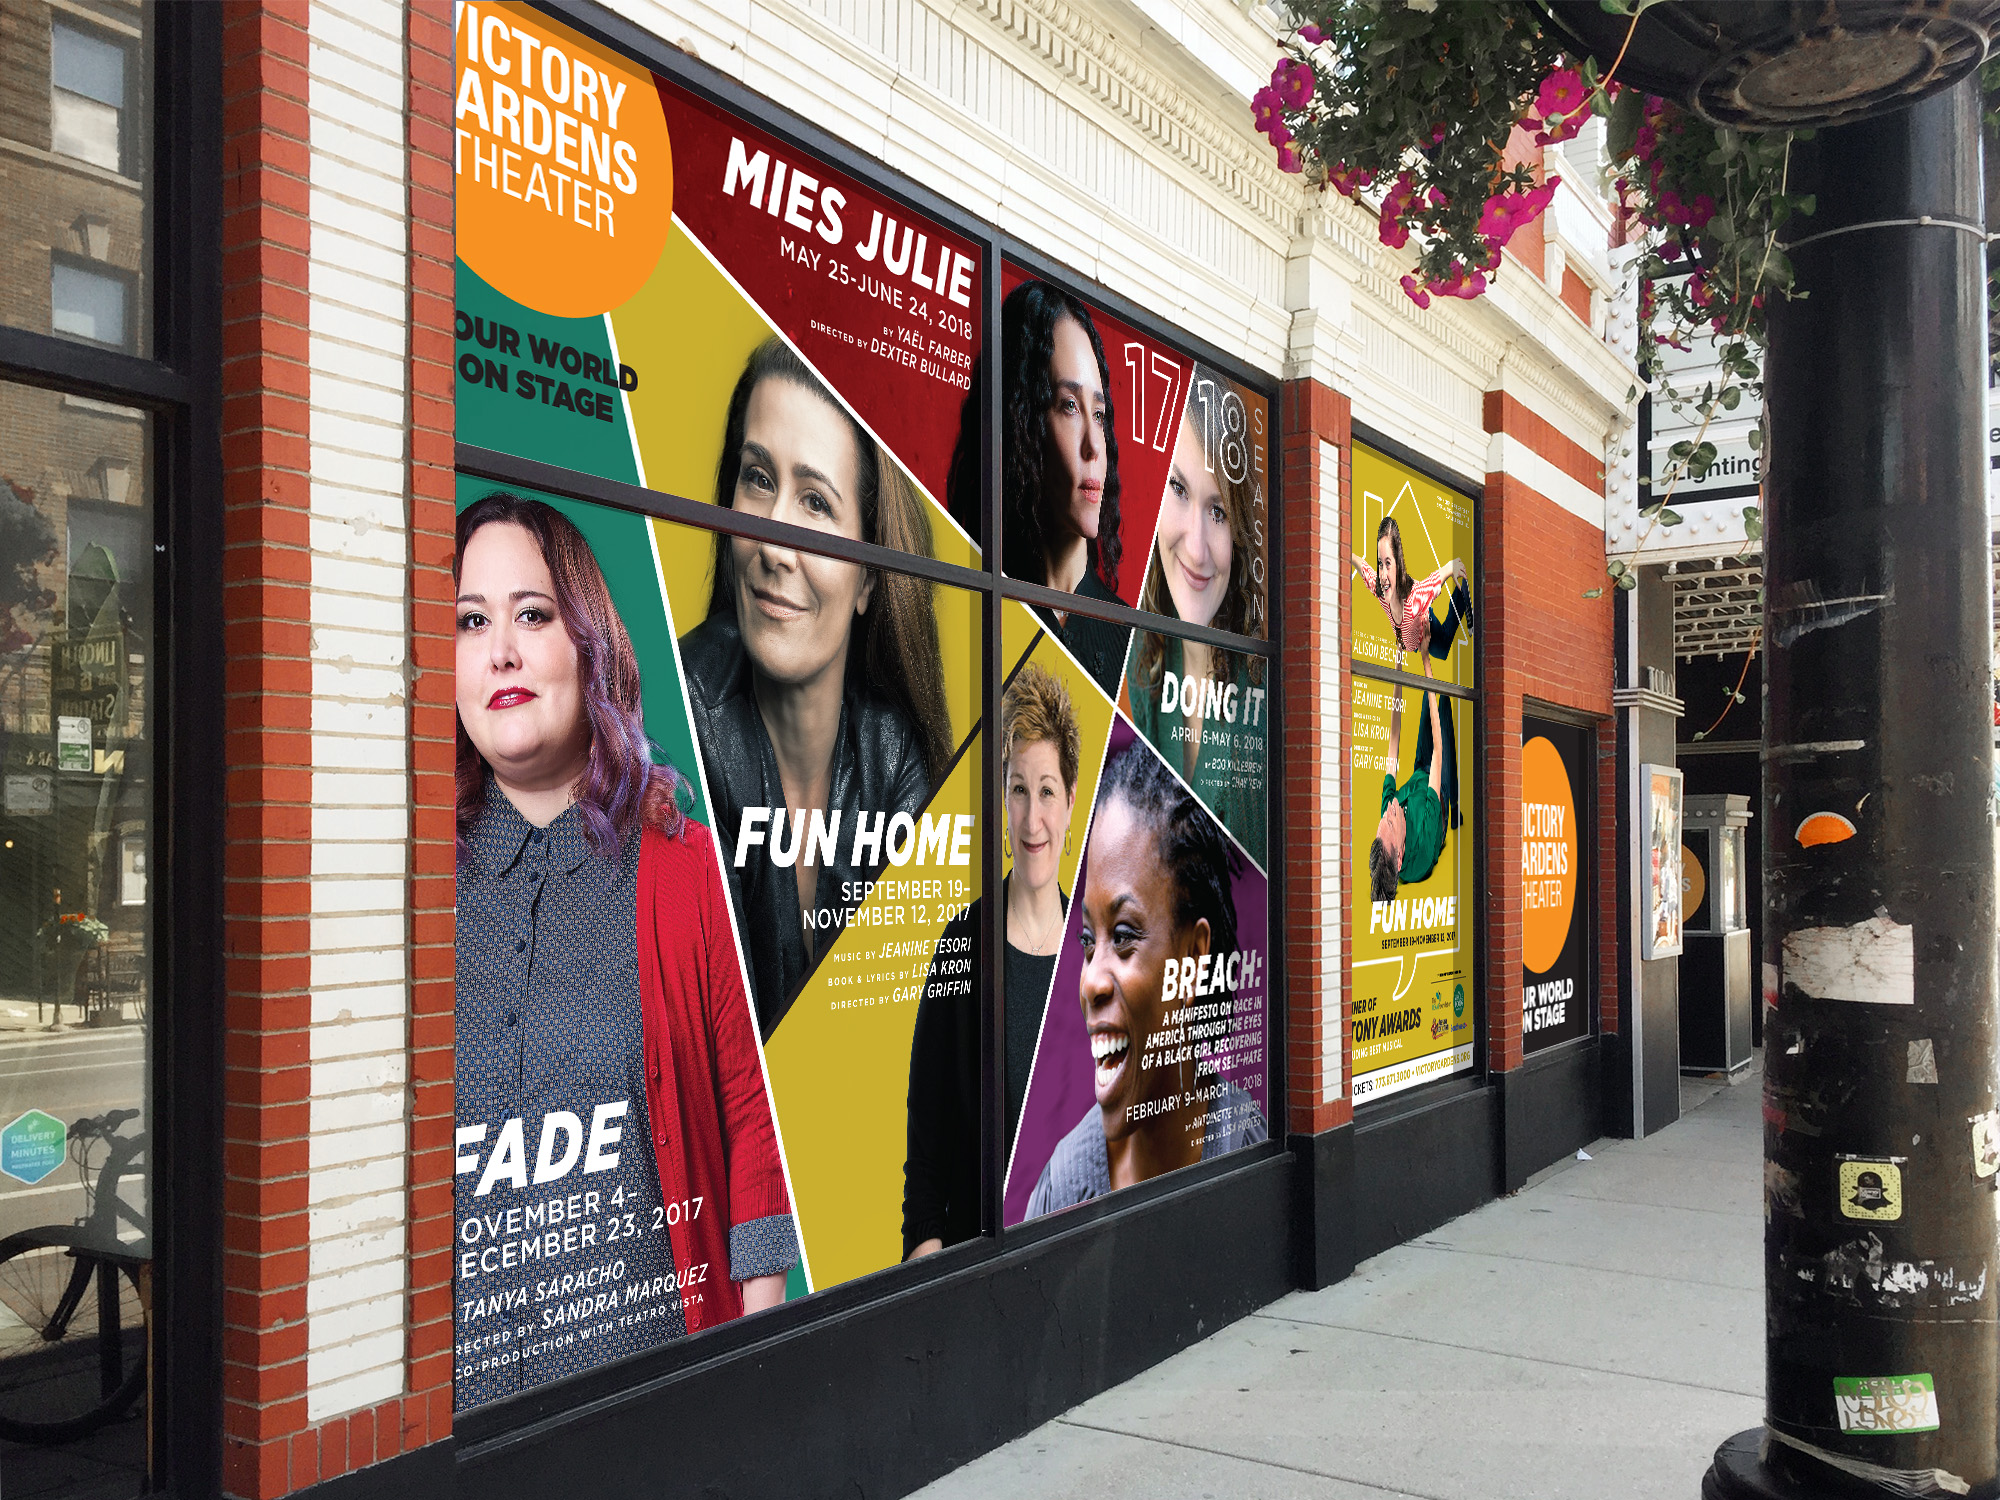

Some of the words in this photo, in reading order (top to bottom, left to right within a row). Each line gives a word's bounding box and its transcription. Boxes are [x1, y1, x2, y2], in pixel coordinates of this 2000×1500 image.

[456, 1, 627, 130] ICTORY
[722, 136, 847, 245] MIES
[855, 209, 975, 308] JULIE
[780, 236, 821, 271] MAY
[828, 259, 903, 310] 25-JUNE
[909, 296, 933, 326] 24,
[938, 310, 972, 340] 2018
[456, 310, 520, 358] OUR
[527, 333, 638, 392] WORLD
[810, 319, 854, 344] DIRECTED
[857, 338, 868, 349] BY
[870, 338, 916, 369] DEXTER
[920, 358, 971, 390] BULLARD
[883, 326, 894, 338] BY
[897, 324, 925, 351] YAËL
[928, 340, 971, 370] FARBER
[458, 353, 508, 393] ON
[515, 370, 613, 423] STAGE
[1124, 342, 1181, 453] 17
[1198, 379, 1247, 484] 18
[1253, 407, 1265, 621] SEASON
[1353, 638, 1378, 658] ALISON
[1160, 670, 1239, 723] DOING
[1243, 686, 1265, 726] IT
[1171, 726, 1200, 744] APRIL
[1202, 730, 1230, 747] 6-MAY
[1243, 735, 1263, 750] 2018
[1353, 721, 1369, 738] LISA
[1370, 724, 1390, 741] KRON
[1354, 753, 1373, 769] GARY
[733, 806, 842, 868] FUN
[850, 810, 975, 867] HOME
[1522, 802, 1565, 838] ICTORY
[841, 880, 942, 902] SEPTEMBER
[1522, 880, 1562, 909] HEATER
[803, 906, 905, 930] NOVEMBER
[911, 905, 931, 926] 12,
[936, 903, 971, 923] 2017
[1369, 899, 1408, 934] FUN
[1410, 896, 1457, 930] HOME
[833, 951, 862, 963] MUSIC
[865, 950, 876, 960] BY
[878, 940, 931, 959] JEANINE
[933, 937, 971, 955] TESORI
[827, 976, 853, 987] BOOK
[866, 972, 896, 983] LYRICS
[899, 970, 909, 979] BY
[911, 962, 937, 979] LISA
[940, 958, 971, 975] KRON
[1161, 949, 1262, 1002] BREACH:
[830, 997, 875, 1010] DIRECTED
[878, 995, 889, 1005] BY
[892, 986, 925, 1003] GARY
[927, 979, 971, 999] GRIFFIN
[1368, 997, 1377, 1011] OF
[1537, 978, 1574, 1006] WORLD
[1162, 1011, 1170, 1027] A
[1171, 1002, 1218, 1025] MANIFESTO
[1220, 1000, 1232, 1016] ON
[1233, 997, 1253, 1014] RACE
[1254, 995, 1263, 1011] IN
[1379, 1007, 1421, 1038] AWARDS
[1523, 1010, 1532, 1033] N
[1534, 1001, 1565, 1030] STAGE
[1141, 1053, 1154, 1070] OF
[1155, 1051, 1162, 1067] A
[1164, 1045, 1193, 1066] BLACK
[1194, 1041, 1212, 1059] GIRL
[1214, 1030, 1262, 1054] RECOVERING
[1145, 1027, 1185, 1050] AMERICA
[1187, 1019, 1227, 1041] THROUGH
[1228, 1016, 1242, 1033] THE
[1244, 1013, 1262, 1030] EYES
[1197, 1058, 1221, 1077] FROM
[1222, 1048, 1263, 1071] SELF-HATE
[1126, 1094, 1182, 1123] FEBRUARY
[1183, 1085, 1229, 1107] 9-MARCH
[1243, 1073, 1262, 1091] 2018
[11, 1130, 56, 1144] DELIVERY
[11, 1145, 55, 1159] MINUTES
[607, 1213, 642, 1242] 23,
[652, 1196, 703, 1229] 2017
[462, 1287, 527, 1323] TANYA
[535, 1260, 625, 1302] SARACHO
[517, 1322, 534, 1338] BY
[542, 1291, 618, 1330] SANDRA
[625, 1263, 708, 1306] MARQUEZ
[581, 1322, 613, 1339] WITH
[620, 1305, 666, 1327] TEATRO
[672, 1294, 704, 1310] VISTA
